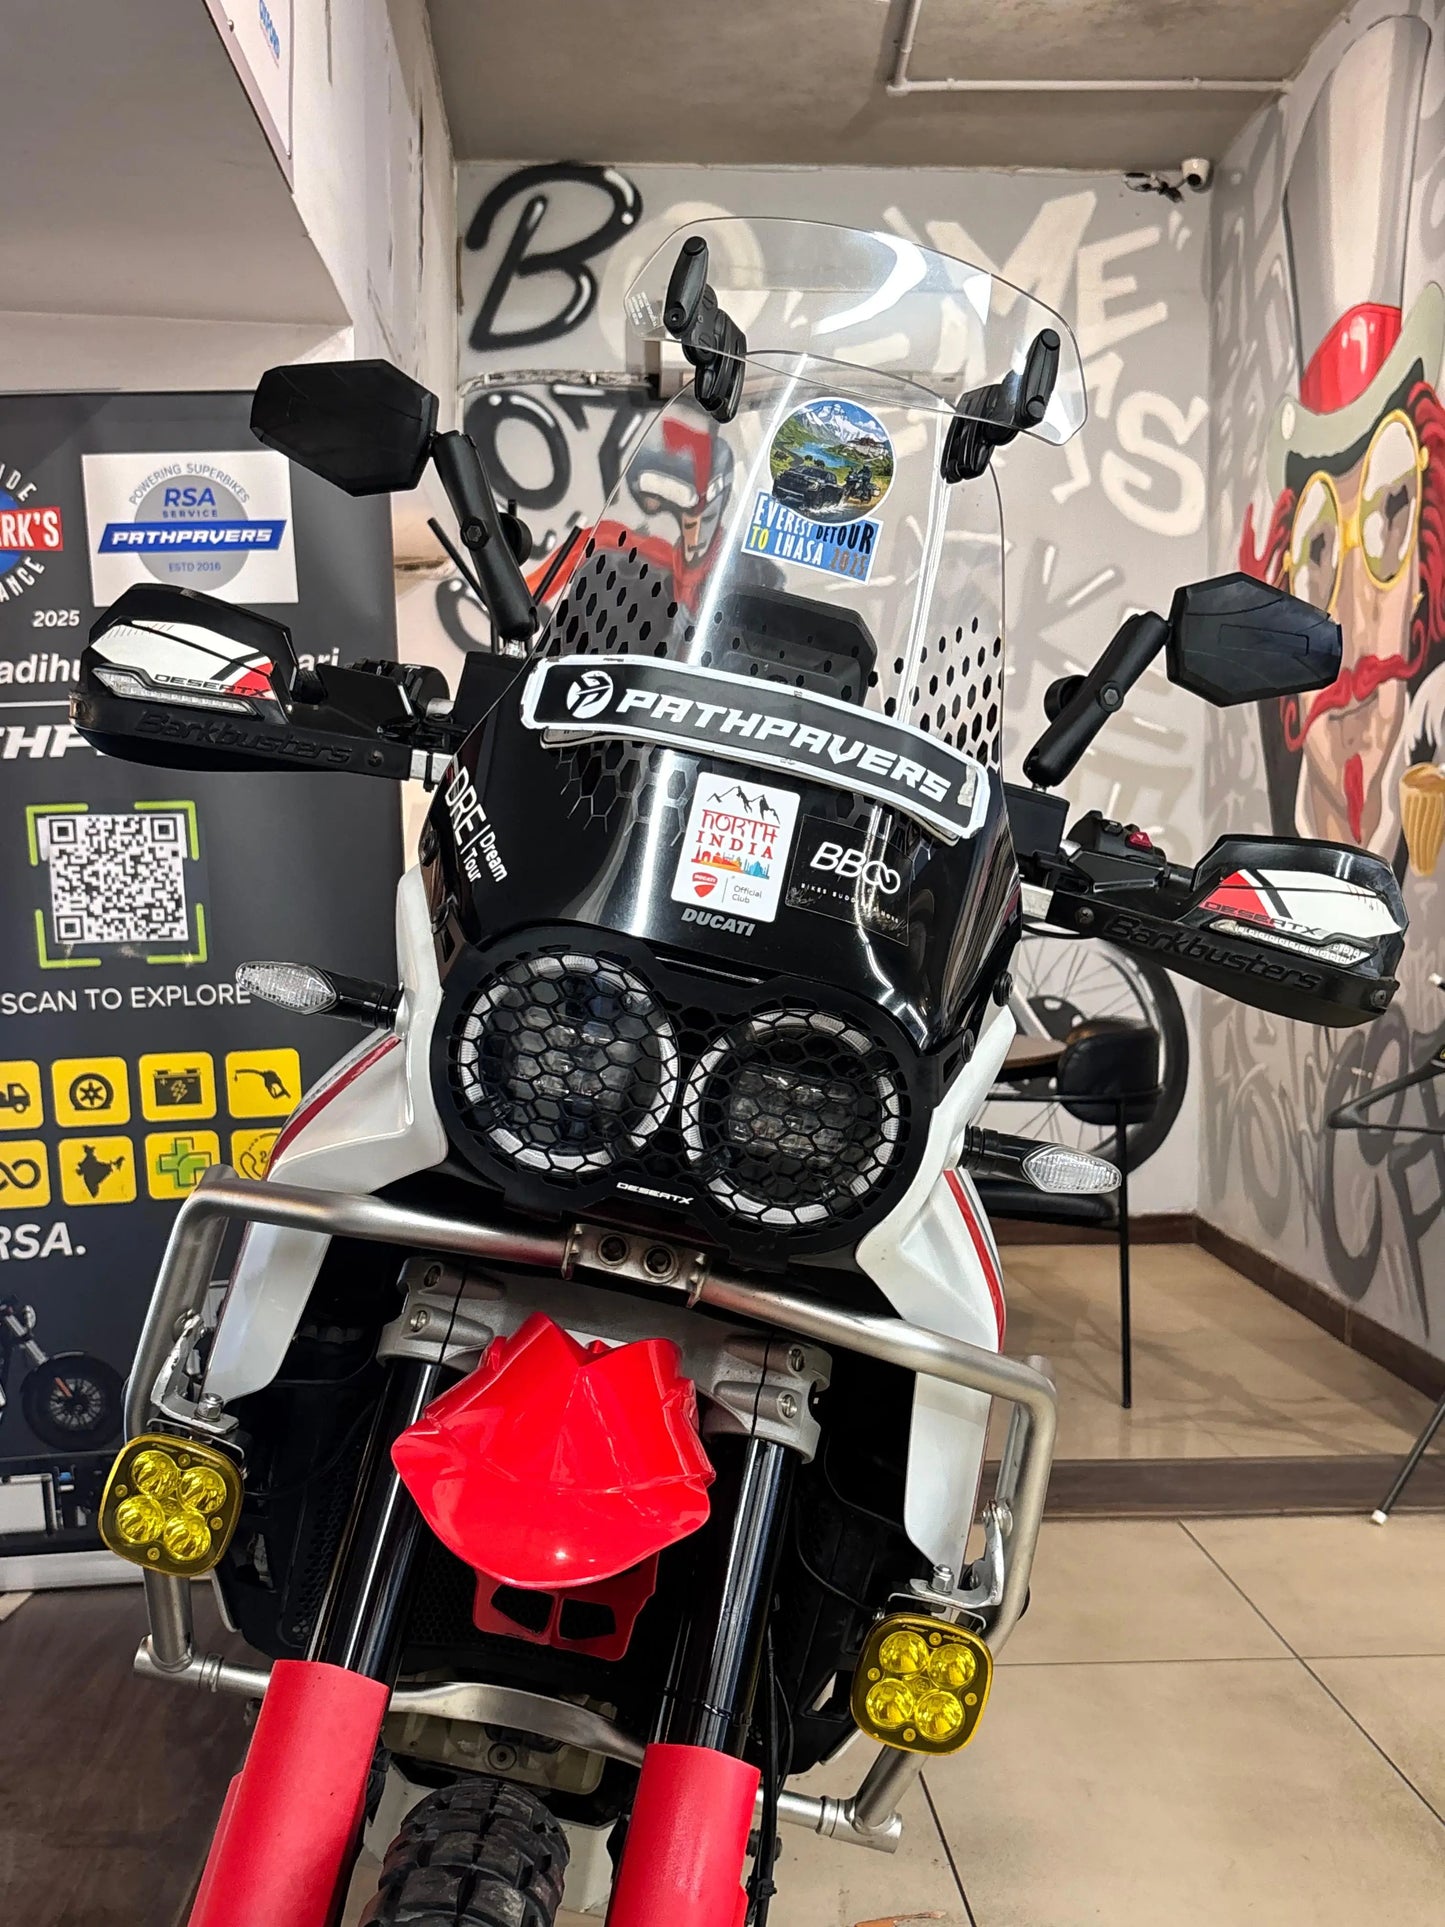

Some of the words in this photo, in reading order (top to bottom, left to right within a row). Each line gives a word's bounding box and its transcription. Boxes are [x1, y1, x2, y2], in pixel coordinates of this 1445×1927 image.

[129, 464, 182, 506] POWERING
[186, 463, 250, 503] SUPERBIKES
[163, 487, 216, 507] RSA
[0, 510, 59, 548] RK'S
[162, 509, 218, 518] SERVICE
[753, 495, 813, 537] EVEREST
[815, 522, 874, 554] DETOUR
[112, 529, 273, 545] PATHPAVERS
[749, 525, 769, 550] TO
[774, 532, 824, 565] LHASA
[168, 562, 195, 572] ESTD
[32, 610, 80, 628] 2025
[154, 673, 272, 697] DESERTX
[135, 709, 353, 763] Barkbusters
[616, 688, 952, 803] PATHPAVERS
[444, 766, 487, 846] DRE
[479, 831, 508, 882] Dream
[696, 830, 773, 860] INDIA
[463, 847, 482, 882] Tour
[731, 894, 750, 904] Club
[733, 884, 762, 899] Official
[681, 907, 756, 937] DUCATI
[1200, 900, 1323, 936] DESERTX
[1102, 914, 1324, 990] Barkbusters
[1, 989, 78, 1015] SCAN
[84, 987, 123, 1010] TO
[130, 983, 251, 1008] EXPLORE
[616, 1181, 695, 1205] DESERTX
